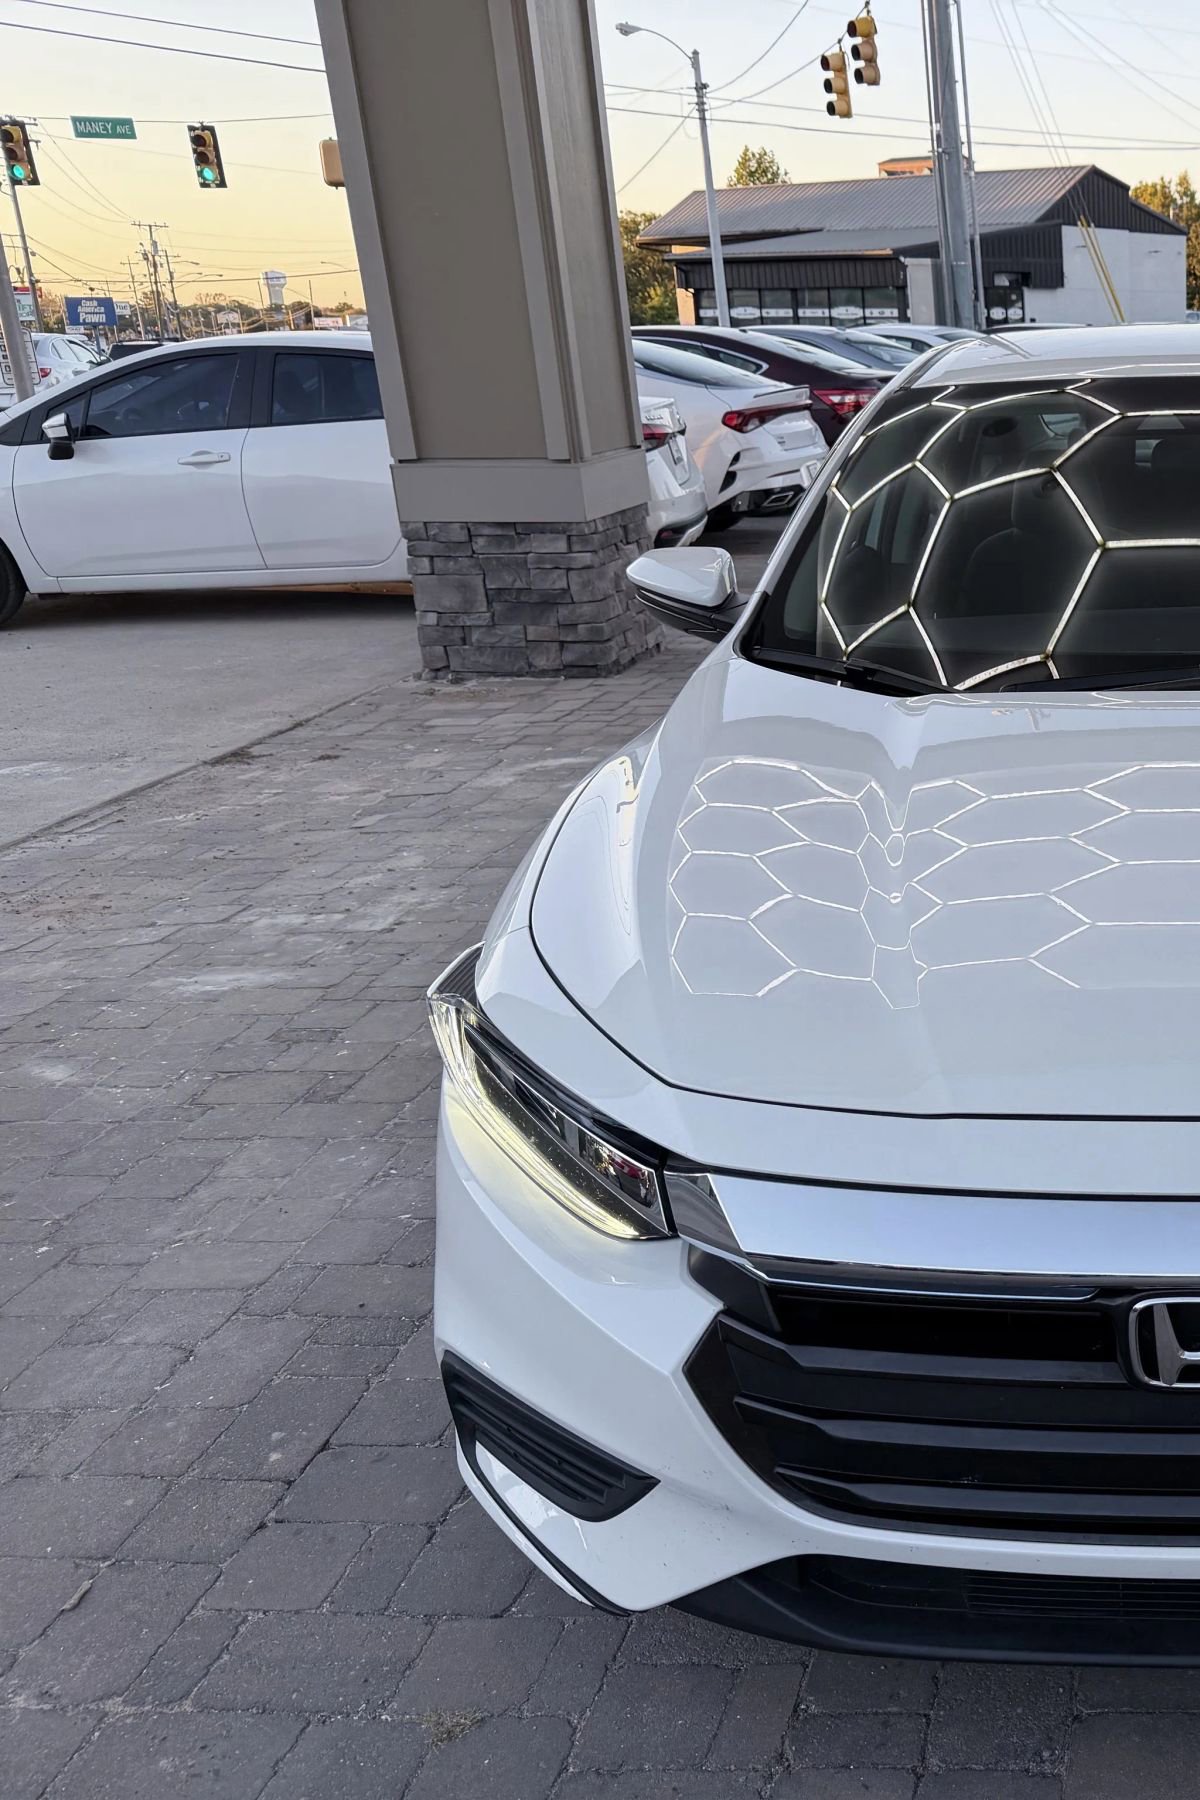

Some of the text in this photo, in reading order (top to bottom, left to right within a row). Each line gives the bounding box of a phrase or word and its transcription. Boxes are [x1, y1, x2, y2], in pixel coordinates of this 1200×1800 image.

[76, 121, 132, 134] MANEY AVE
[81, 299, 98, 307] Cash
[79, 313, 106, 323] Pawn
